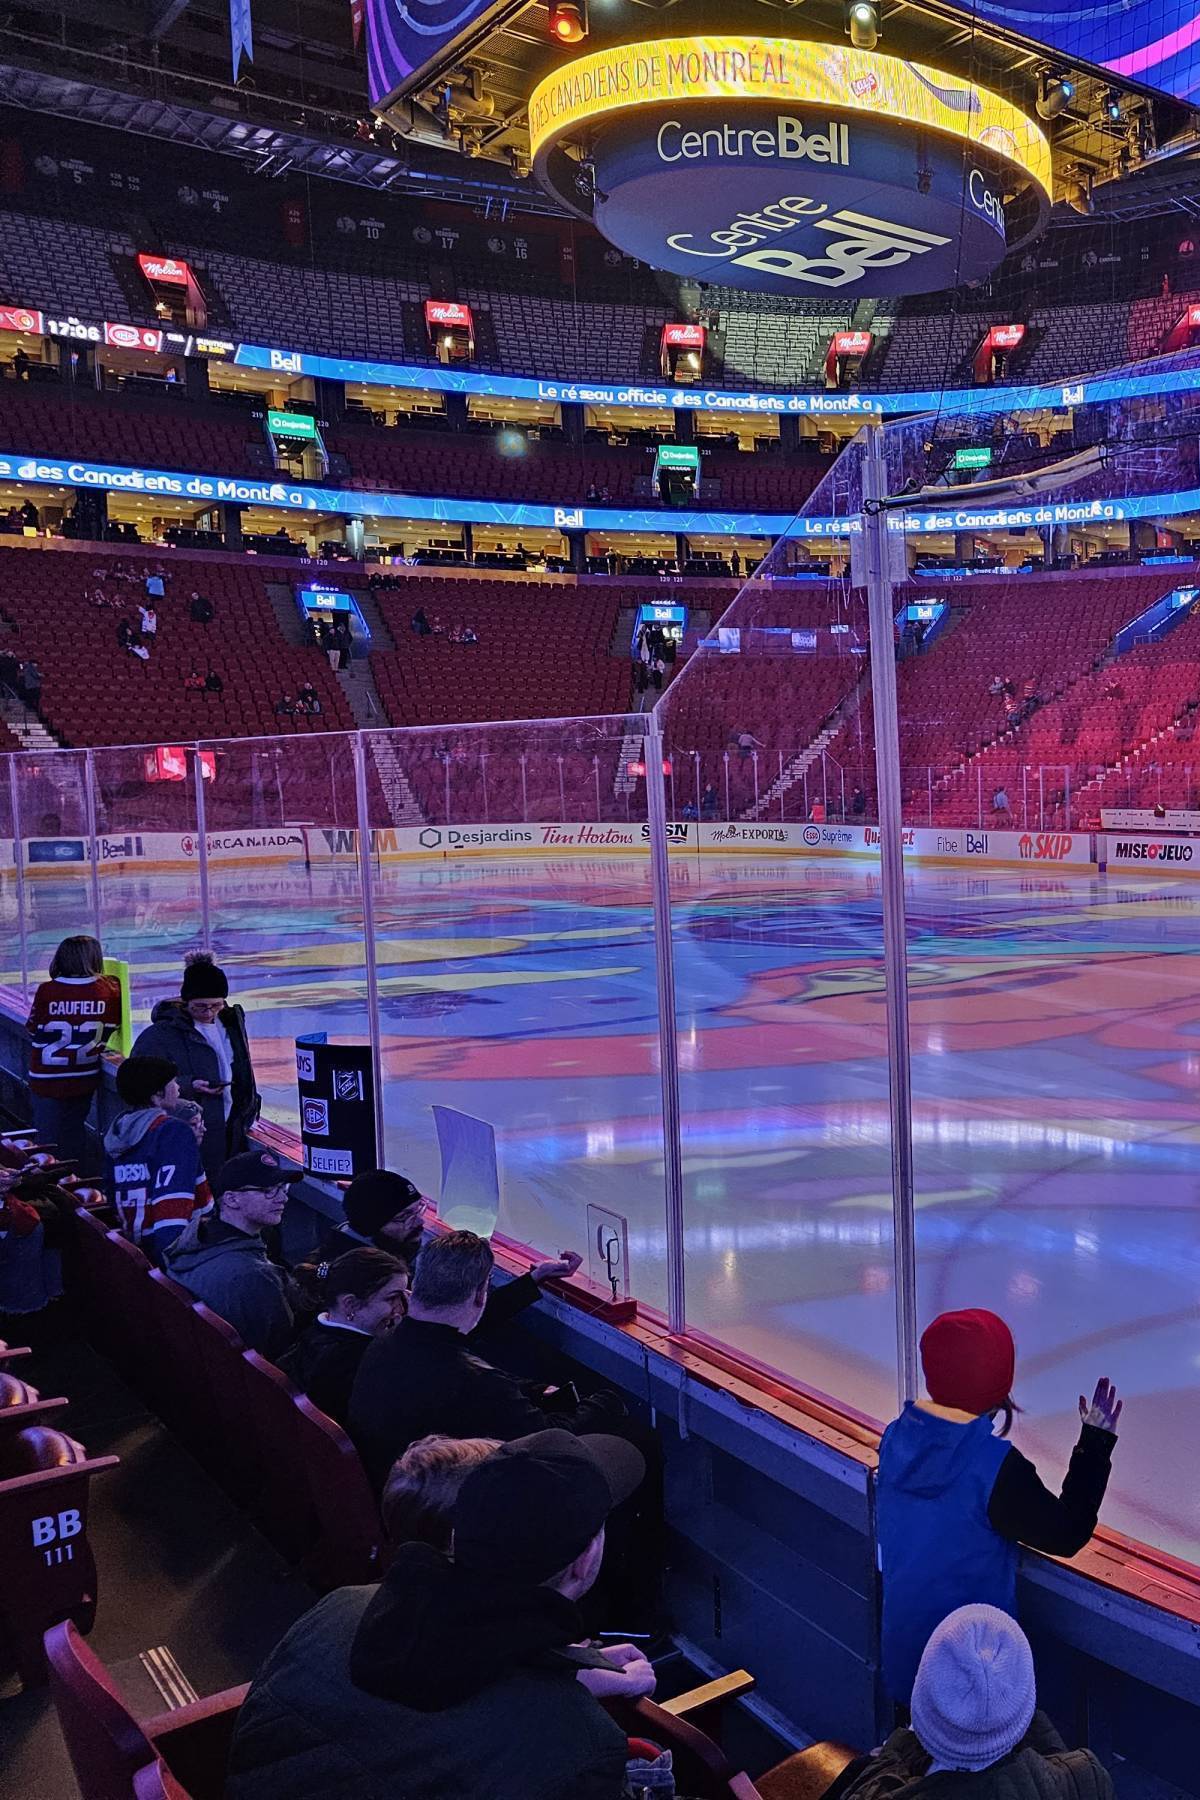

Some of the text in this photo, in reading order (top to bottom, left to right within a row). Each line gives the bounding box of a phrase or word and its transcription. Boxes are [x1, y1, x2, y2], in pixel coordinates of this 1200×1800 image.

[550, 60, 631, 118] CANADIENS
[636, 55, 662, 89] DE
[667, 44, 790, 86] MONTRÉAL
[666, 196, 828, 257] Centre
[730, 210, 952, 288] Bell
[144, 261, 183, 277] Molson
[431, 307, 465, 321] Molson
[143, 332, 157, 347] 0
[270, 350, 302, 372] Bell
[538, 382, 557, 398] Le
[671, 391, 701, 407] des
[704, 392, 785, 410] Canadiens
[788, 396, 807, 411] de
[1062, 384, 1084, 405] Bell
[18, 461, 63, 481] des
[67, 464, 182, 493] Canadiens
[187, 477, 213, 496] de
[554, 509, 584, 527] Bell
[805, 519, 823, 533] Le
[924, 514, 953, 530] des
[955, 510, 1032, 528] Canadiens
[1035, 508, 1052, 523] de
[316, 594, 336, 607] Bell
[654, 607, 672, 619] Bell
[917, 606, 932, 618] Bell
[448, 829, 532, 845] Desjardins
[540, 825, 633, 845] Tim Hortons
[822, 829, 853, 843] Suprême
[937, 834, 988, 854] Fibe Bell
[1033, 834, 1073, 860] SKIP
[49, 1001, 106, 1015] CAUFIELD
[41, 1020, 104, 1066] 22
[296, 1055, 312, 1073] UYS
[313, 1156, 351, 1172] SELFIE?
[155, 1164, 176, 1188] 17
[32, 1508, 82, 1547] BB
[44, 1544, 73, 1566] 111
